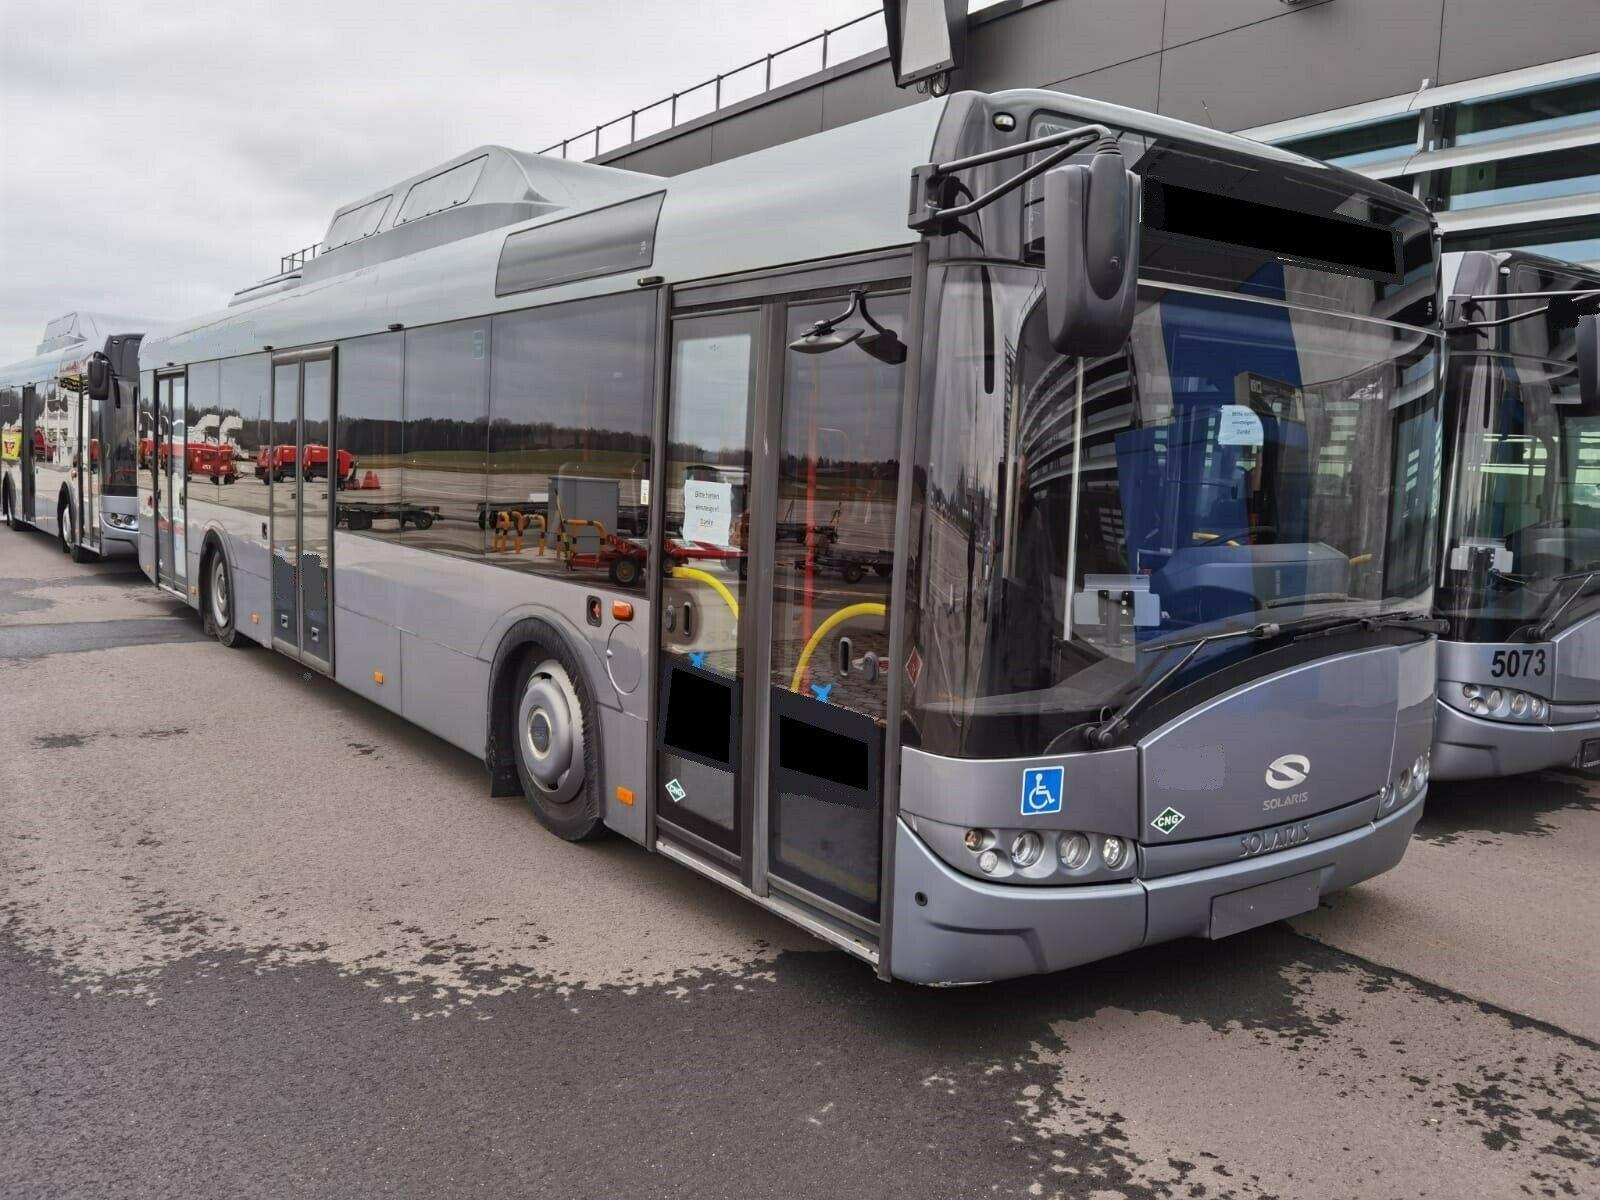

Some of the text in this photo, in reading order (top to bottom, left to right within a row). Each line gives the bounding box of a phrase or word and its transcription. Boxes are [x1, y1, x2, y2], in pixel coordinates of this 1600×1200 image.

[1491, 649, 1546, 678] 5073
[1262, 791, 1309, 811] SOLARIS
[1157, 814, 1179, 827] CNG
[1239, 823, 1312, 858] SOLARIS
